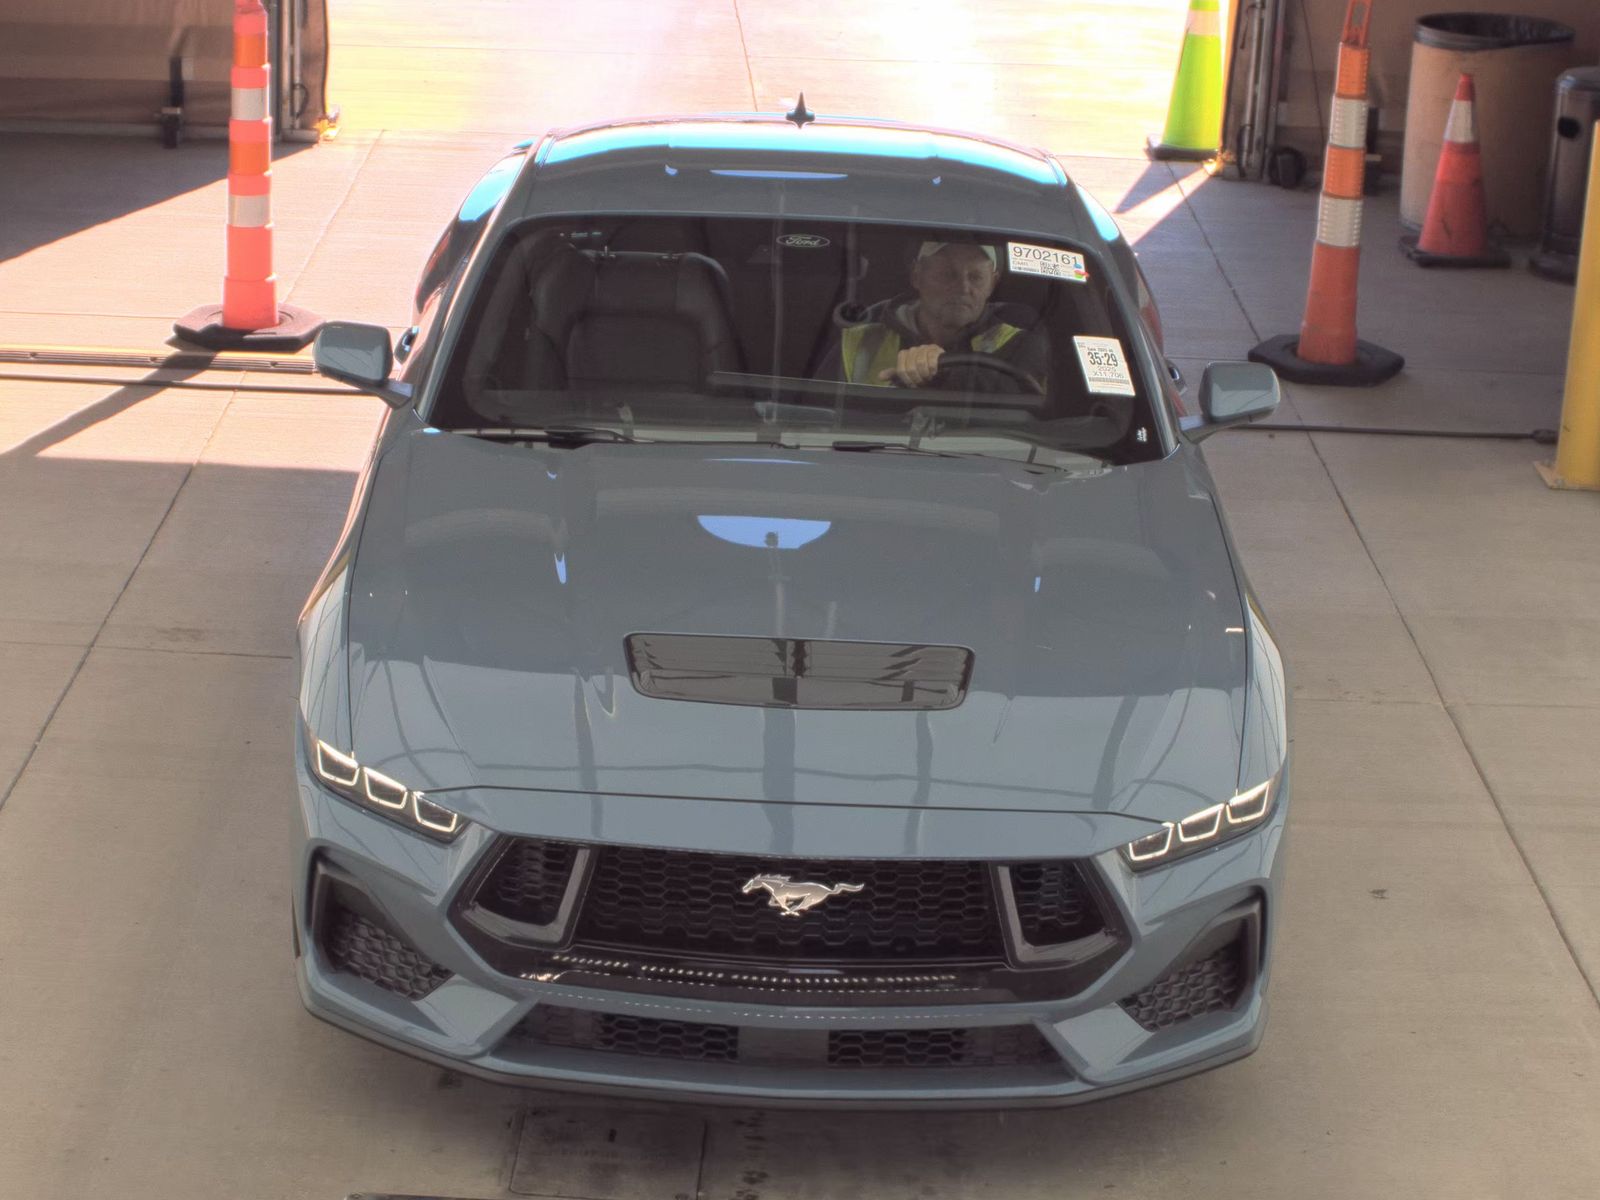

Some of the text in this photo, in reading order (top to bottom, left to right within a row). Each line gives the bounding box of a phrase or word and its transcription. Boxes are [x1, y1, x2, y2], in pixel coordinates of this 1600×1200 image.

[785, 235, 821, 247] Ford
[1013, 246, 1079, 266] 9702161
[1087, 351, 1119, 367] 35:29
